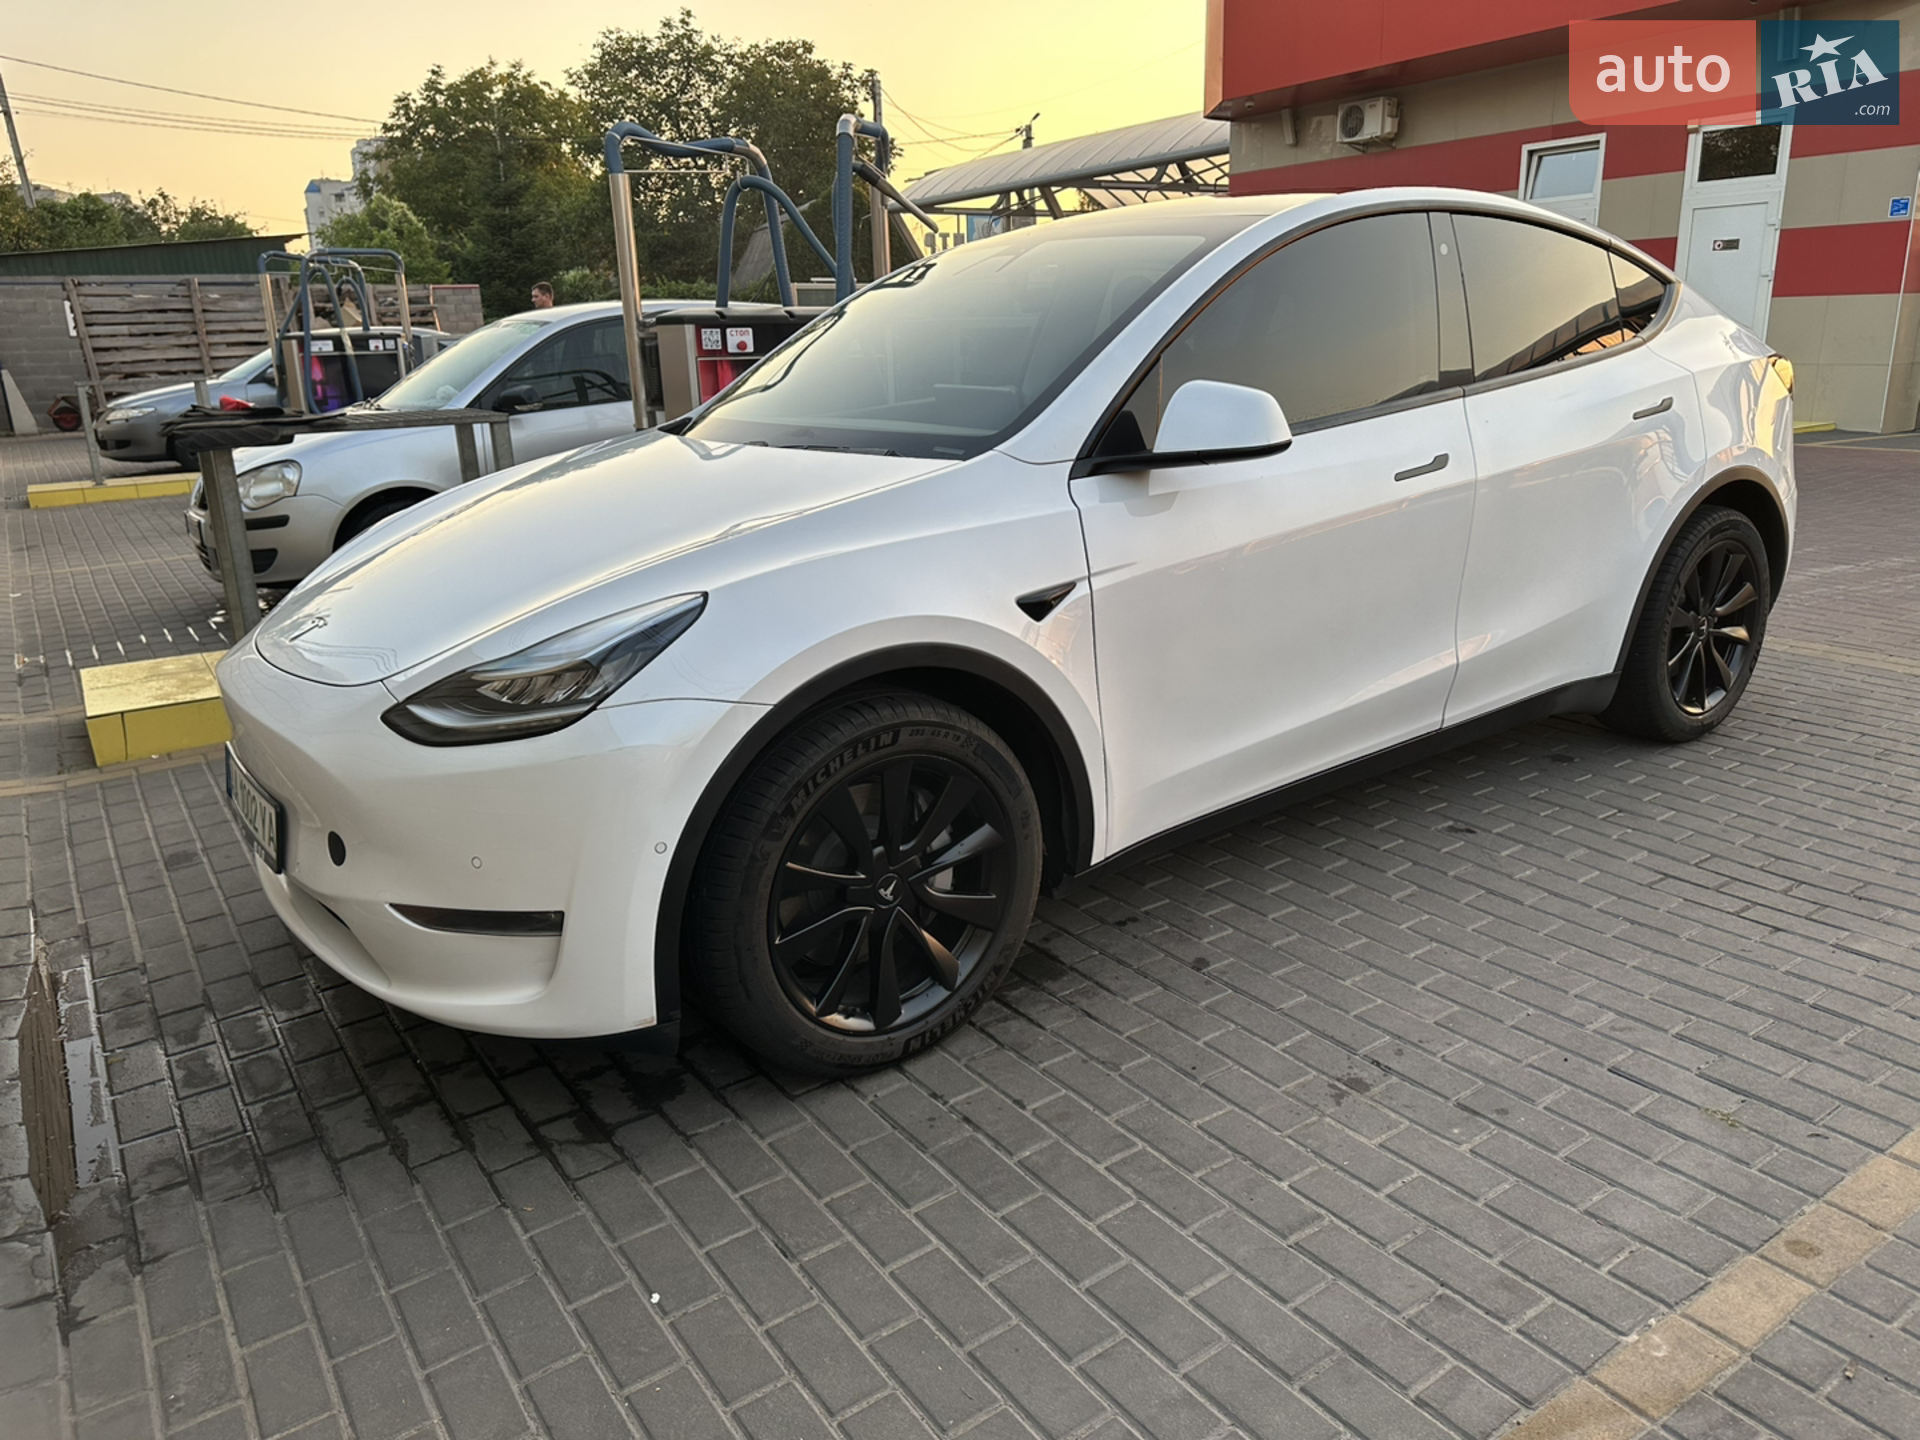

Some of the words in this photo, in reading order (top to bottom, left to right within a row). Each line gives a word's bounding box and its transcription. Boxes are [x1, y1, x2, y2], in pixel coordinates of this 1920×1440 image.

[729, 329, 750, 337] СТОП
[791, 730, 898, 811] MICHELIN
[951, 733, 961, 742] 19
